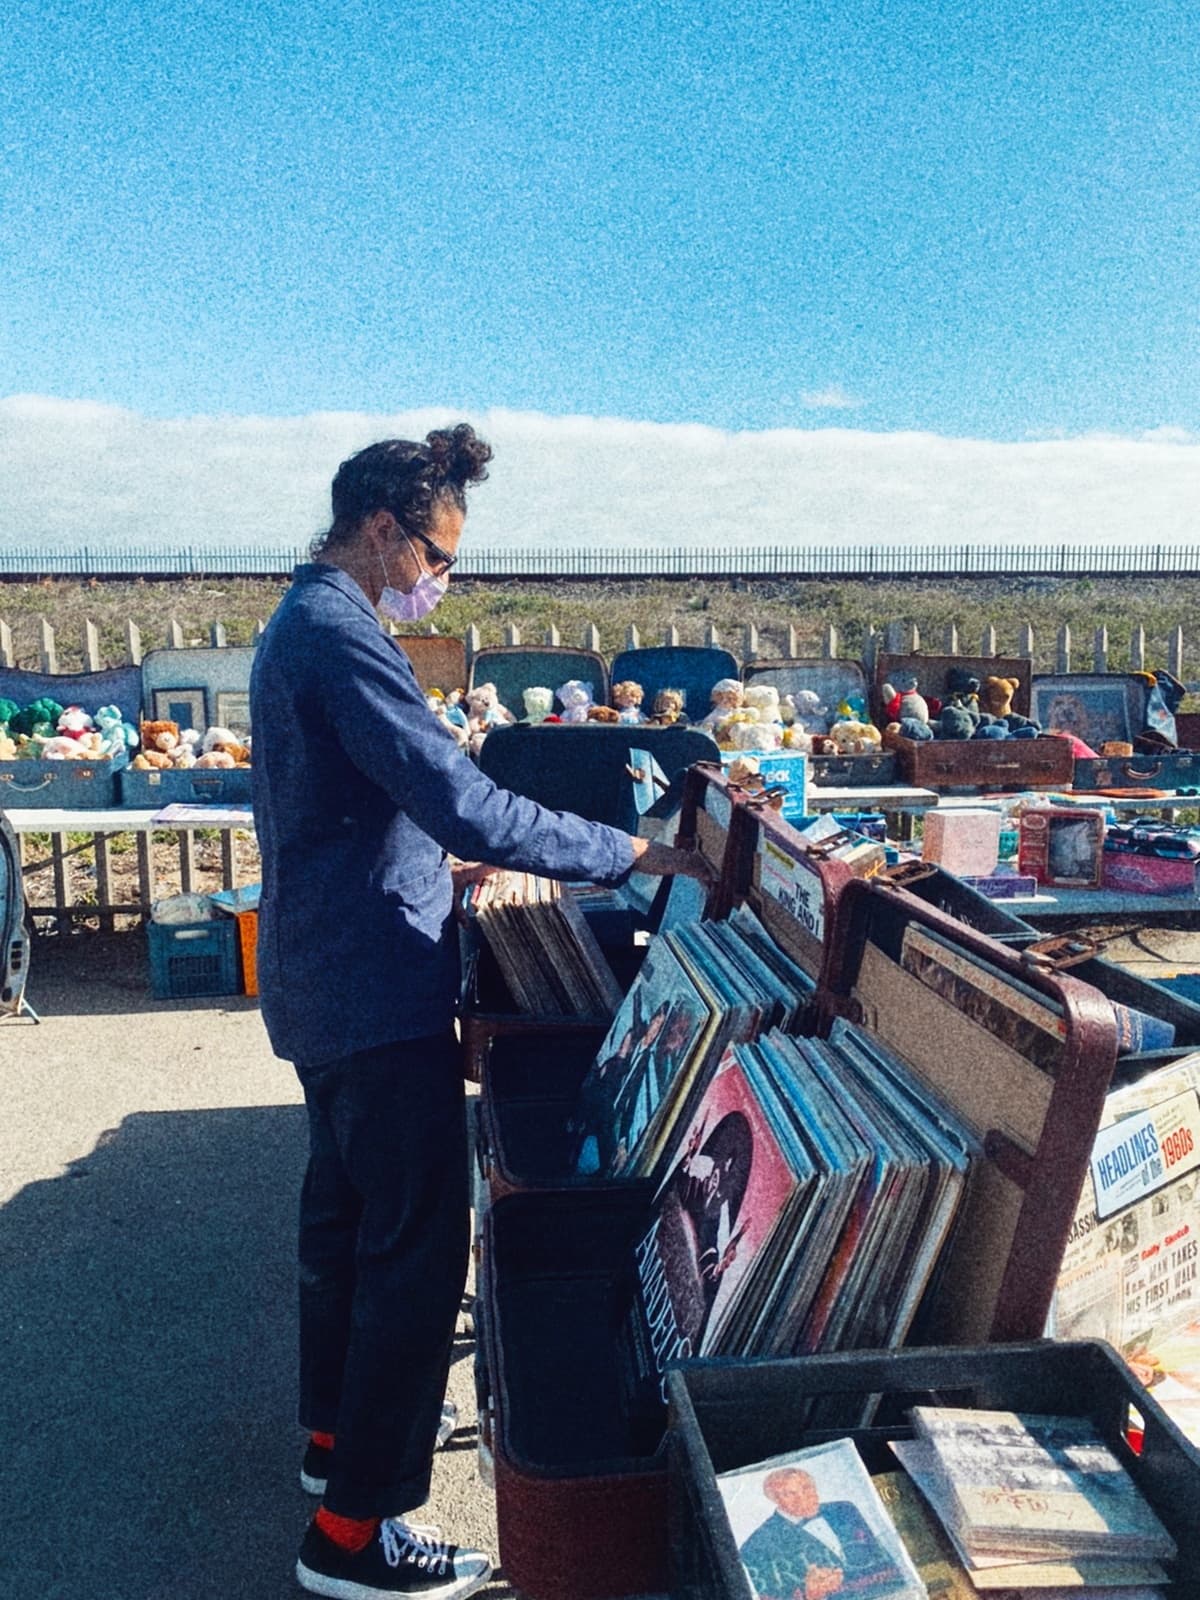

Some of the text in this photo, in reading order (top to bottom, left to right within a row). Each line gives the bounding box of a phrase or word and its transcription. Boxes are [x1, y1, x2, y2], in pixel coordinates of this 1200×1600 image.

[778, 886, 796, 914] KING
[797, 904, 815, 931] AND
[795, 881, 811, 909] THE
[1097, 1122, 1159, 1191] HEADLINES
[1161, 1126, 1194, 1169] 1960s
[1171, 1239, 1198, 1269] TAKES
[1145, 1277, 1169, 1306] FIRST
[1174, 1261, 1197, 1289] WALK
